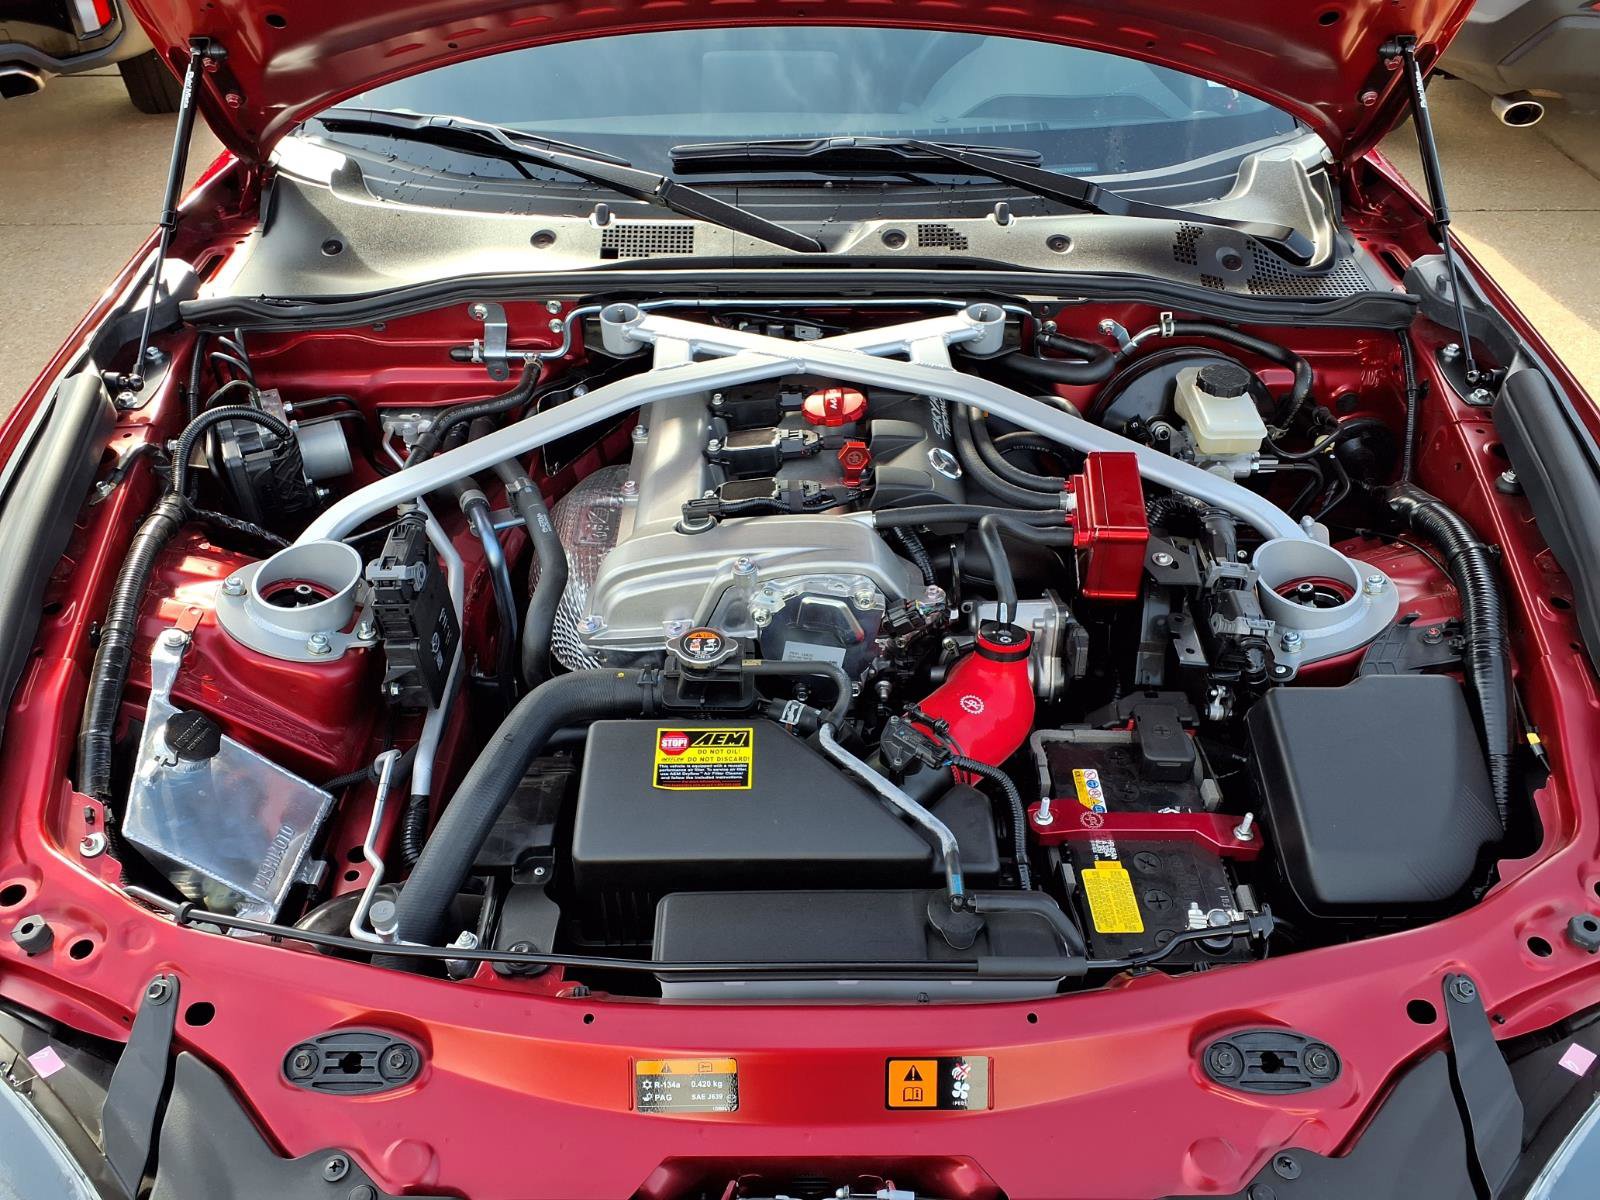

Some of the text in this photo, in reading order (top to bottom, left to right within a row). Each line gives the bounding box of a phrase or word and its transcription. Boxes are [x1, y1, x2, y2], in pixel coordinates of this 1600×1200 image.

[661, 738, 688, 747] STOP!
[690, 731, 748, 747] AEM
[654, 1081, 680, 1089] R-134a
[713, 1080, 723, 1089] kg
[654, 1093, 672, 1101] PAG
